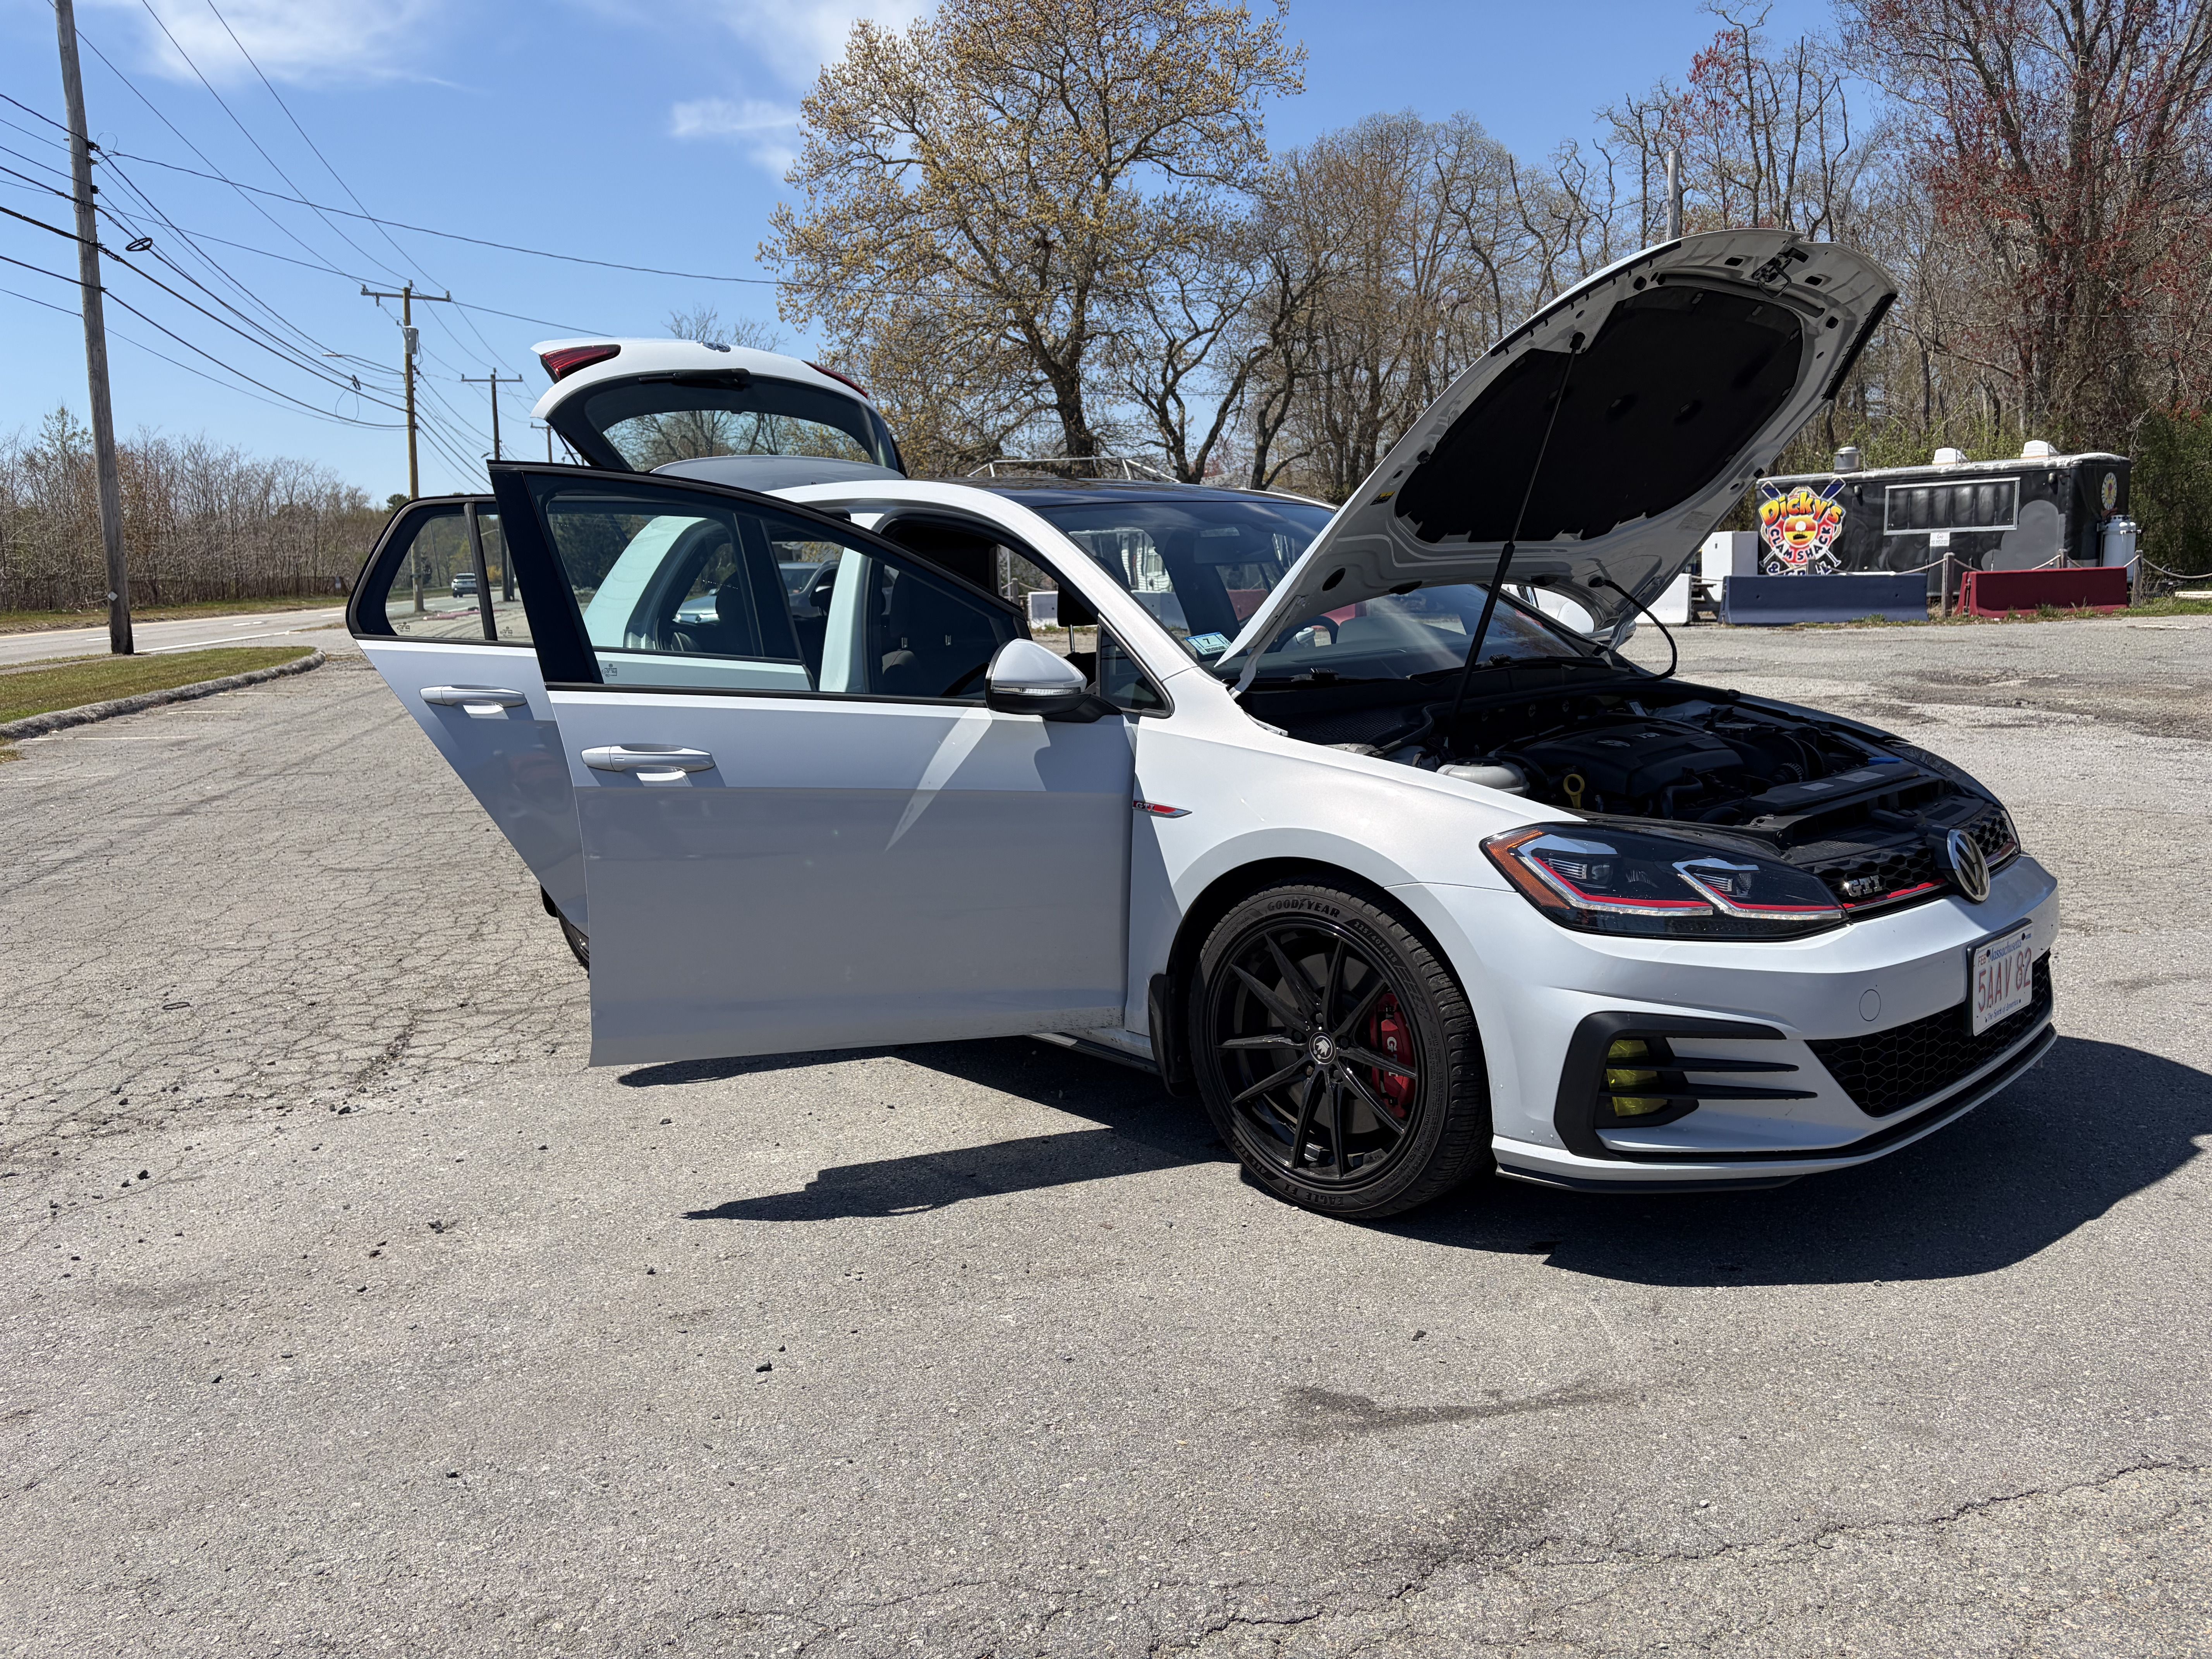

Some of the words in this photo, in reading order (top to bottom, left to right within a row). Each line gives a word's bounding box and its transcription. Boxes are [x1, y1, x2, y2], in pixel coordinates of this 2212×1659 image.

[1760, 491, 1843, 528] Dicky's
[1770, 528, 1793, 559] CLAM
[1797, 527, 1831, 560] SHACK
[1136, 802, 1155, 811] GTI
[1846, 874, 1883, 897] GTI
[1978, 955, 2012, 1013] 5AAV
[2016, 947, 2032, 991] 82
[1252, 1158, 1268, 1174] ALL
[1284, 1183, 1298, 1196] F1
[1305, 1192, 1344, 1206] EAGLE
